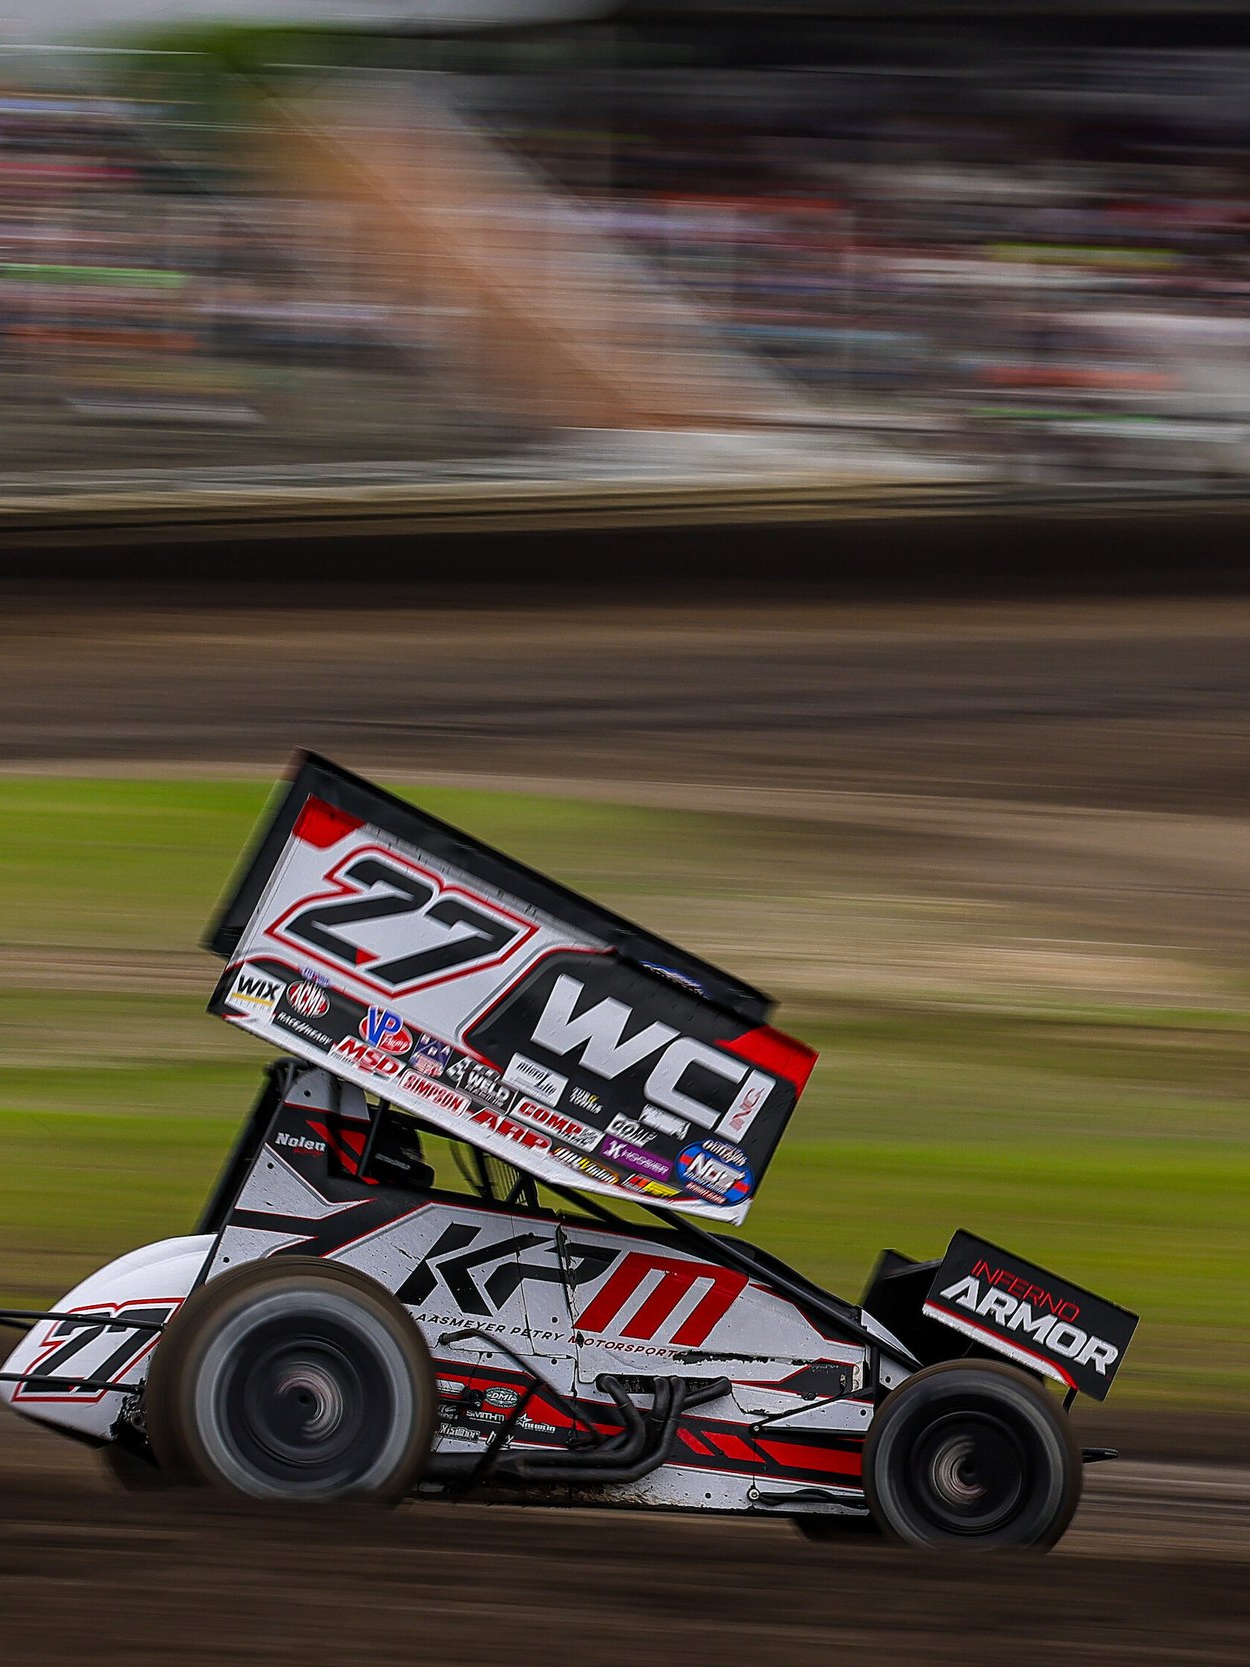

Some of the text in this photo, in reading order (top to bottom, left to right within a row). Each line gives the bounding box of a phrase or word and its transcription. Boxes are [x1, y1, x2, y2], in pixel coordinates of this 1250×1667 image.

[280, 852, 524, 988] 27
[237, 974, 281, 1001] WIX
[366, 1004, 404, 1048] VP
[336, 1039, 400, 1075] MSD
[403, 1073, 463, 1112] SIMPSON
[468, 1072, 511, 1102] WELD
[467, 1108, 551, 1150] ARP
[518, 1100, 582, 1135] COMP
[275, 1132, 326, 1152] Nolen
[621, 1147, 670, 1175] HOOSIER
[970, 1259, 1081, 1323] INFERNO
[510, 1326, 566, 1343] PETRY
[939, 1274, 1119, 1377] ARMOR
[490, 1391, 513, 1402] DMI
